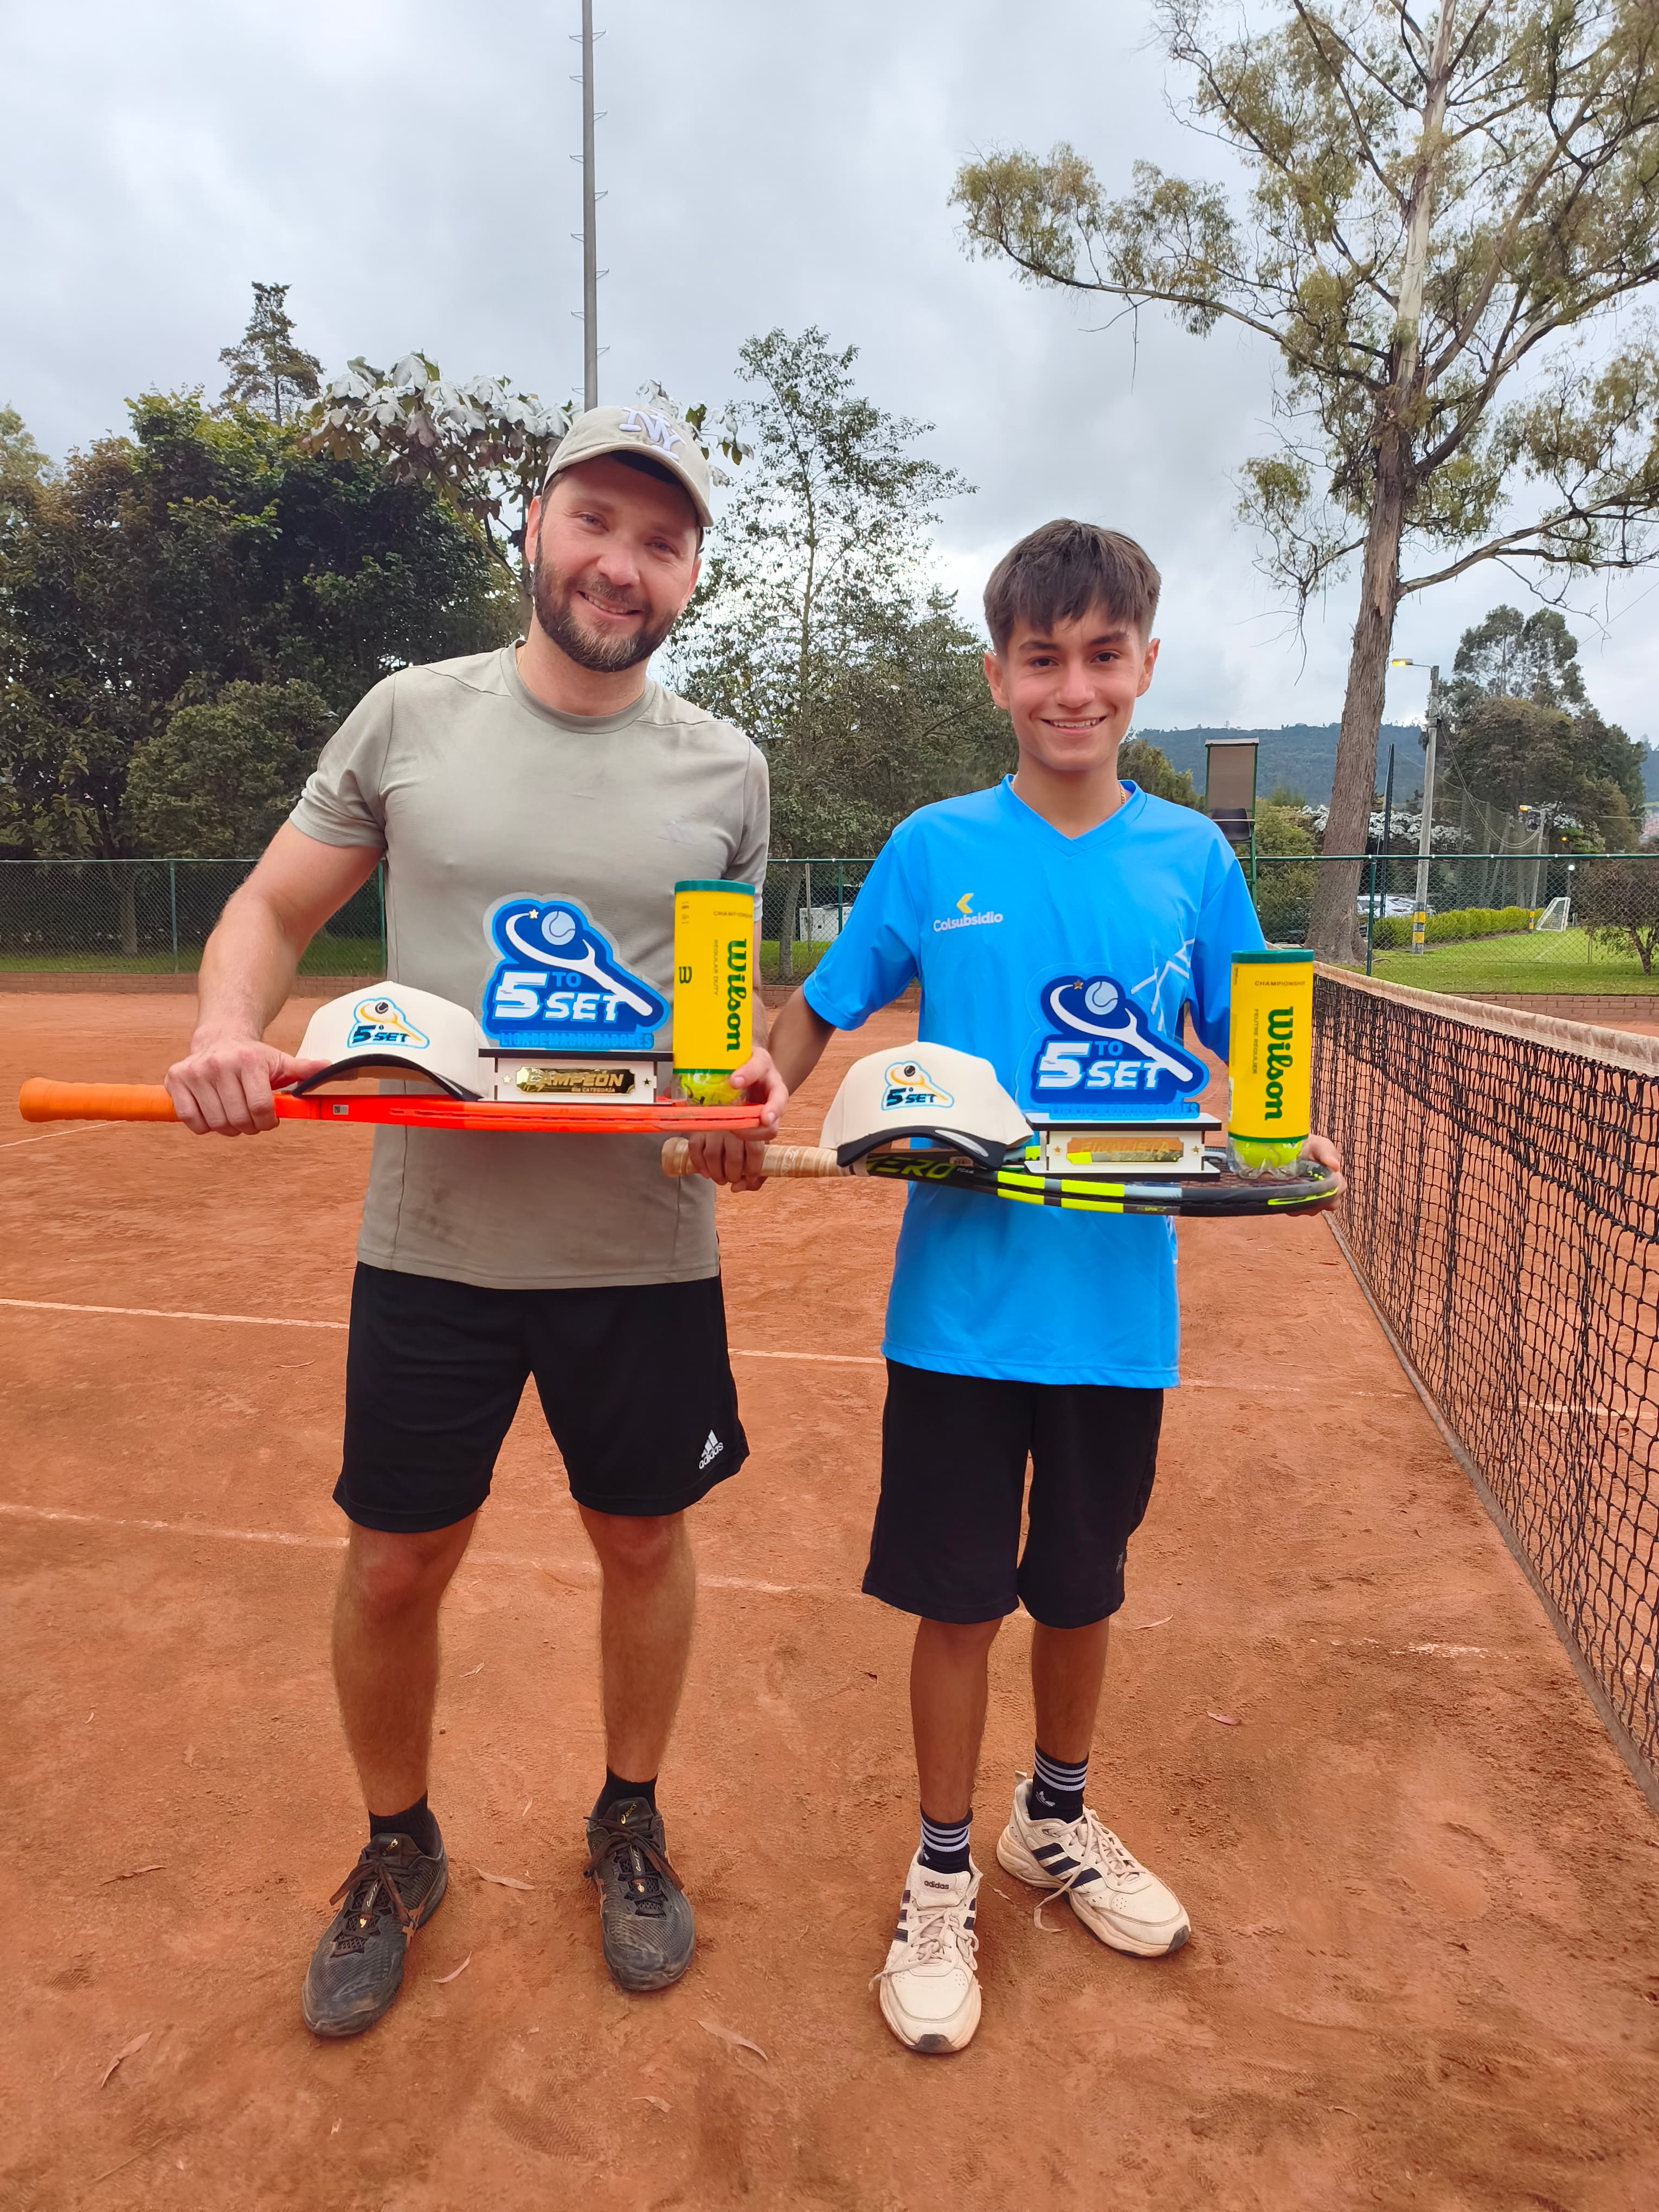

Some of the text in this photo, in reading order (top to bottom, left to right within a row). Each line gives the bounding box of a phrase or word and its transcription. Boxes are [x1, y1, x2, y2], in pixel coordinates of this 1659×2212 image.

[619, 407, 686, 461] NY
[933, 910, 1004, 933] Colsubsidio
[493, 970, 619, 1022] 5 TO SET
[726, 938, 747, 1052] Wilson
[351, 1025, 410, 1044] 5 SET
[1038, 1041, 1159, 1089] 5 TO SET
[1264, 1006, 1294, 1121] Wilson
[886, 1088, 937, 1107] 5 SET
[698, 1442, 724, 1470] adidas
[924, 1880, 949, 1890] adidas
